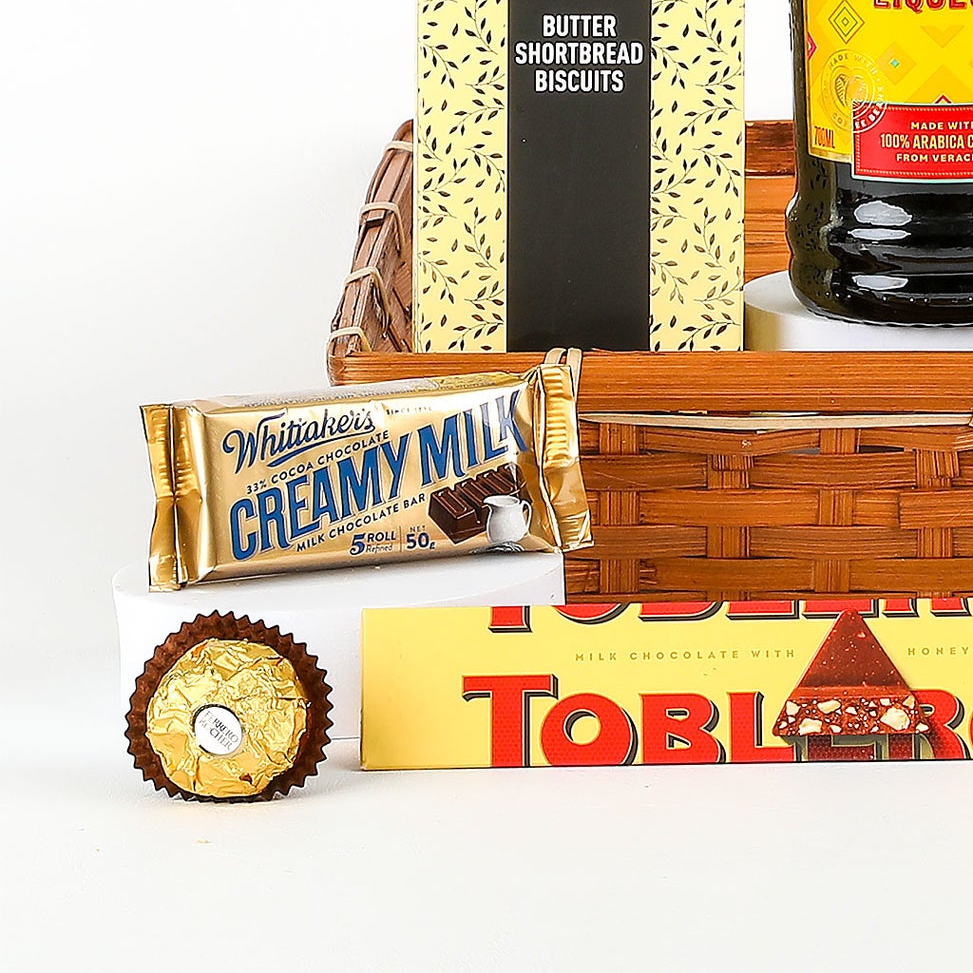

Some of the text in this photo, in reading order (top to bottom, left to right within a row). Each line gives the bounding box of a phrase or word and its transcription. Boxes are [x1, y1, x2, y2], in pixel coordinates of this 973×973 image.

[542, 14, 617, 37] BUTTER
[514, 42, 644, 65] SHORTBREAD
[535, 69, 625, 92] BISCUITS
[911, 121, 944, 130] MADE
[880, 133, 910, 149] 100%
[913, 134, 965, 149] ARABICA
[896, 153, 929, 162] FROM
[247, 429, 389, 494] 33% COCOA CHOCOLATE
[229, 390, 527, 562] CREAMY MILK
[296, 493, 426, 552] MILK CHOCOLATE BAR
[350, 531, 397, 555] 5 ROLL
[366, 544, 393, 553] Refined
[575, 649, 795, 661] MILK CHOCOLATE WITH
[908, 647, 970, 656] HONEY
